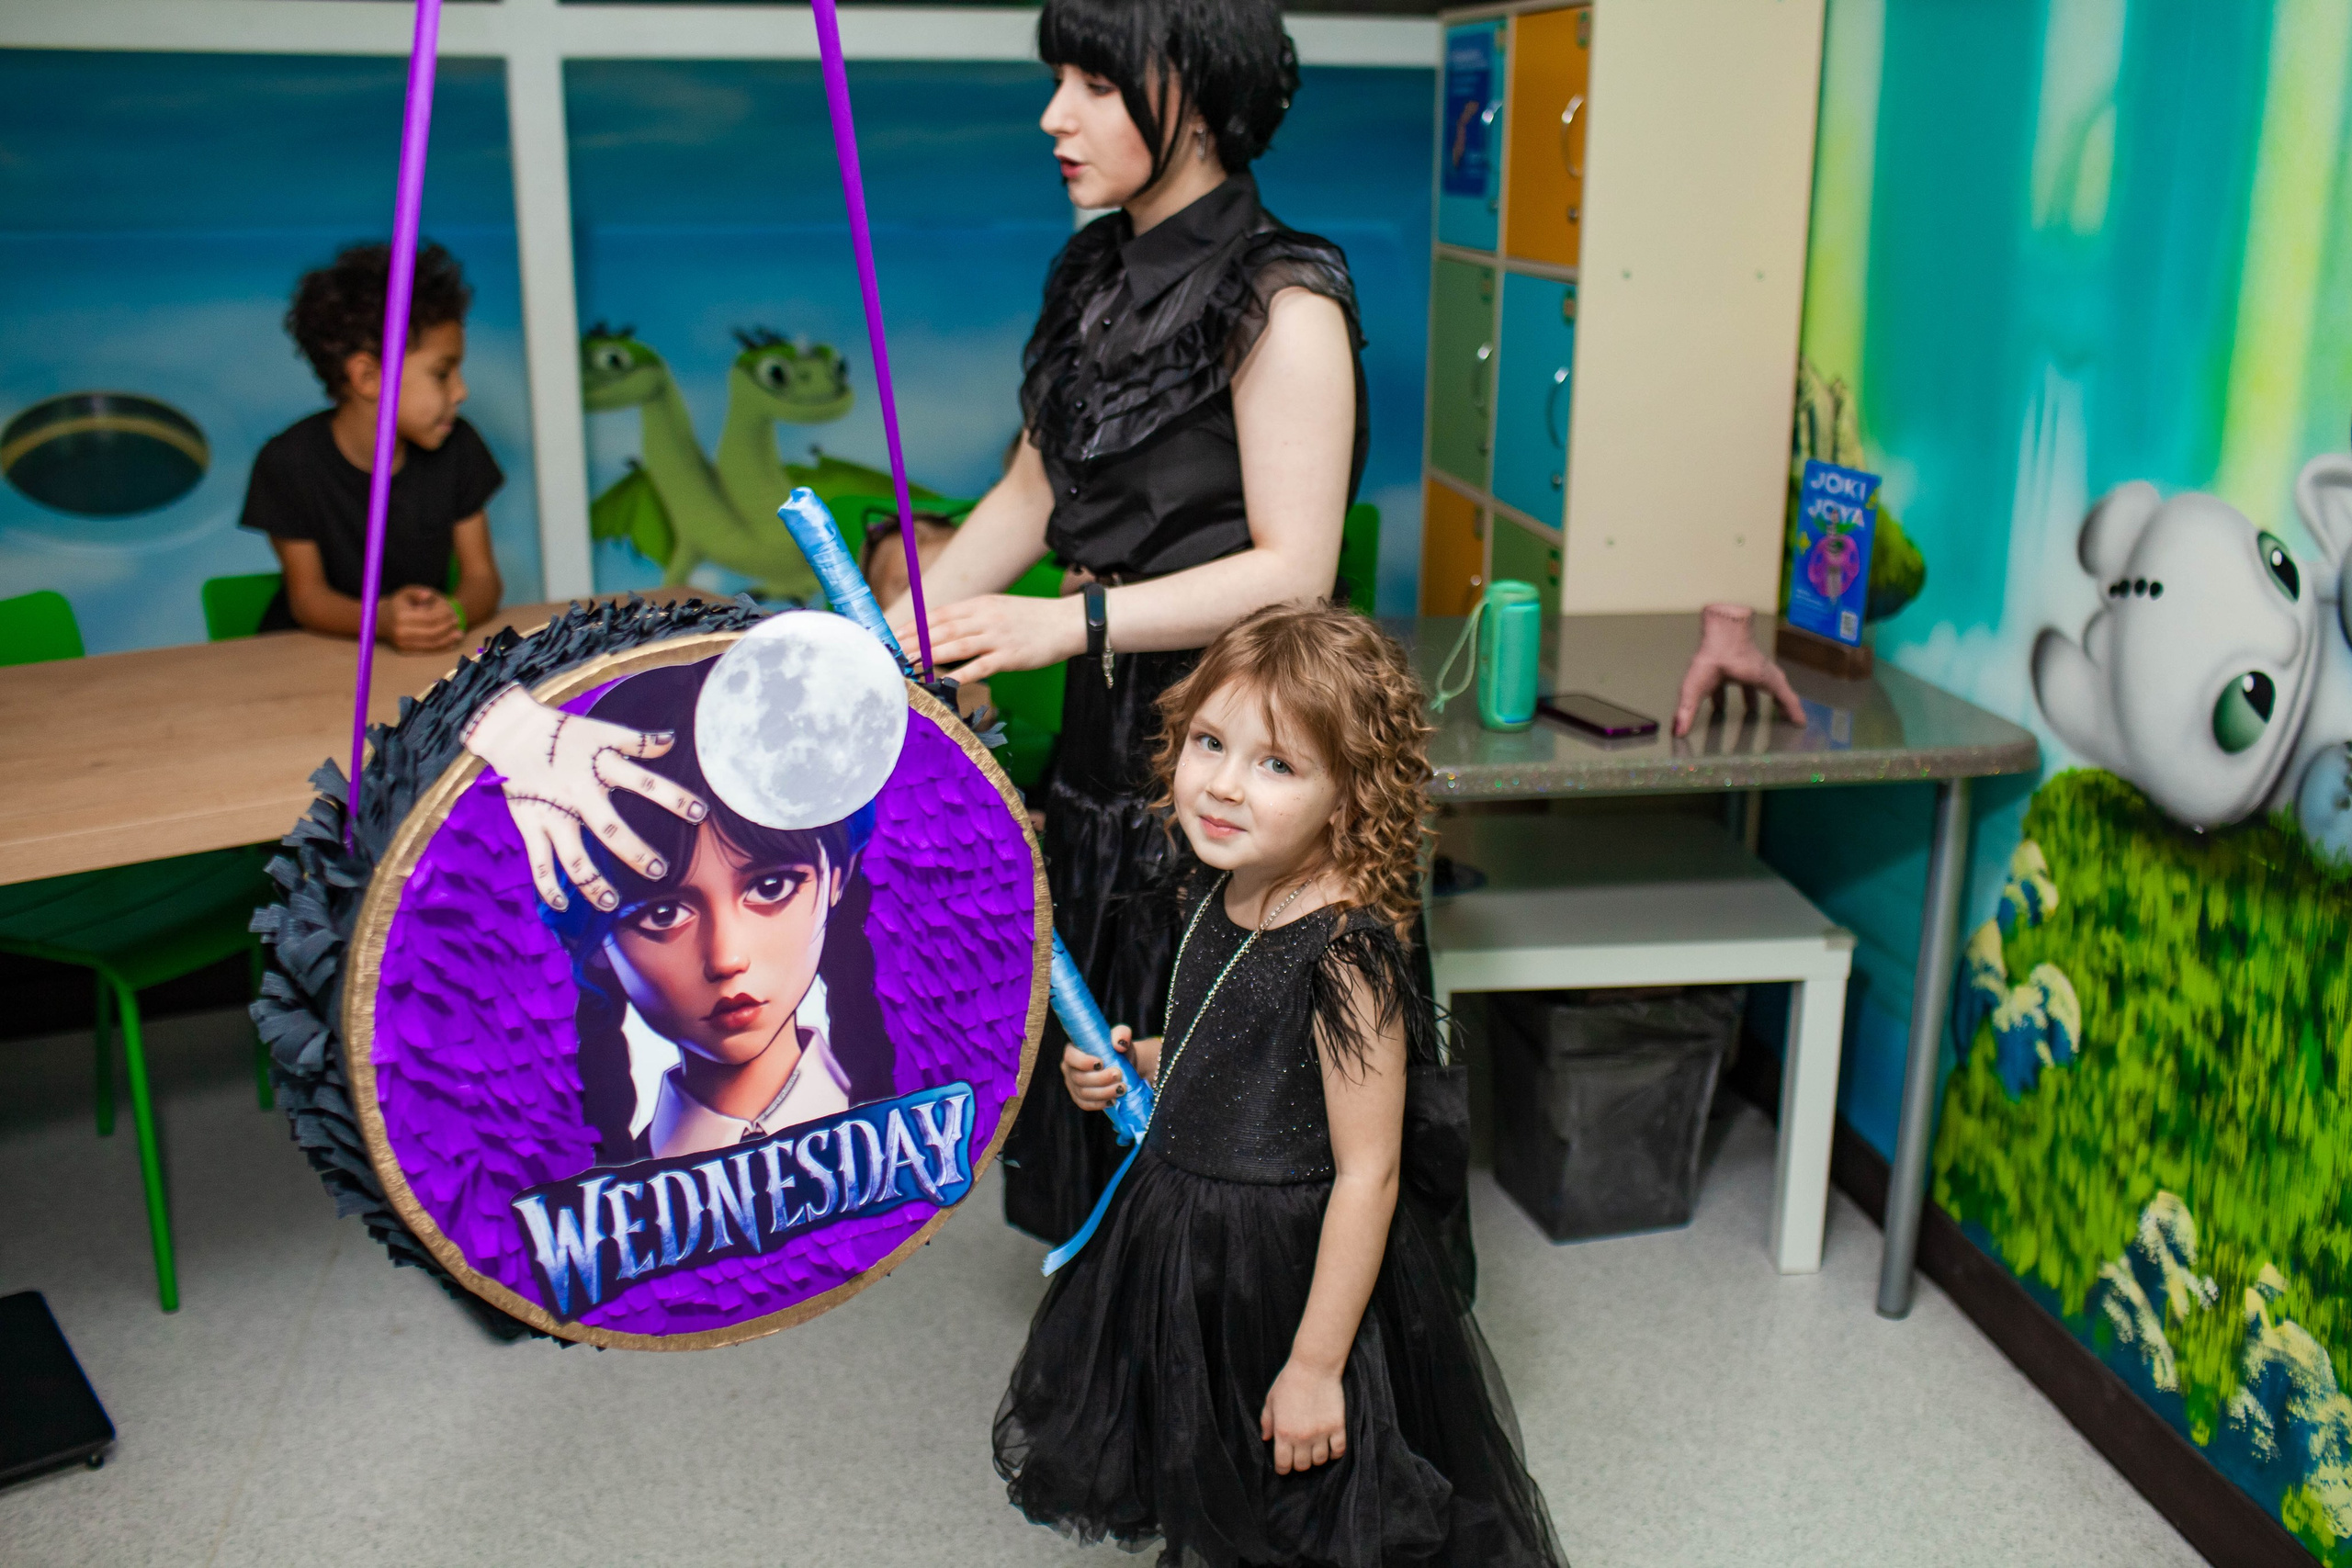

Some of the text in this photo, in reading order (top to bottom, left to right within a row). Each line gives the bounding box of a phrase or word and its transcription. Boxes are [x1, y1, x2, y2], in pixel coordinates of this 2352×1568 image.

[1810, 471, 1866, 502] JOKI
[1807, 499, 1865, 527] JOYA
[512, 1094, 970, 1314] WEDNESDAY
